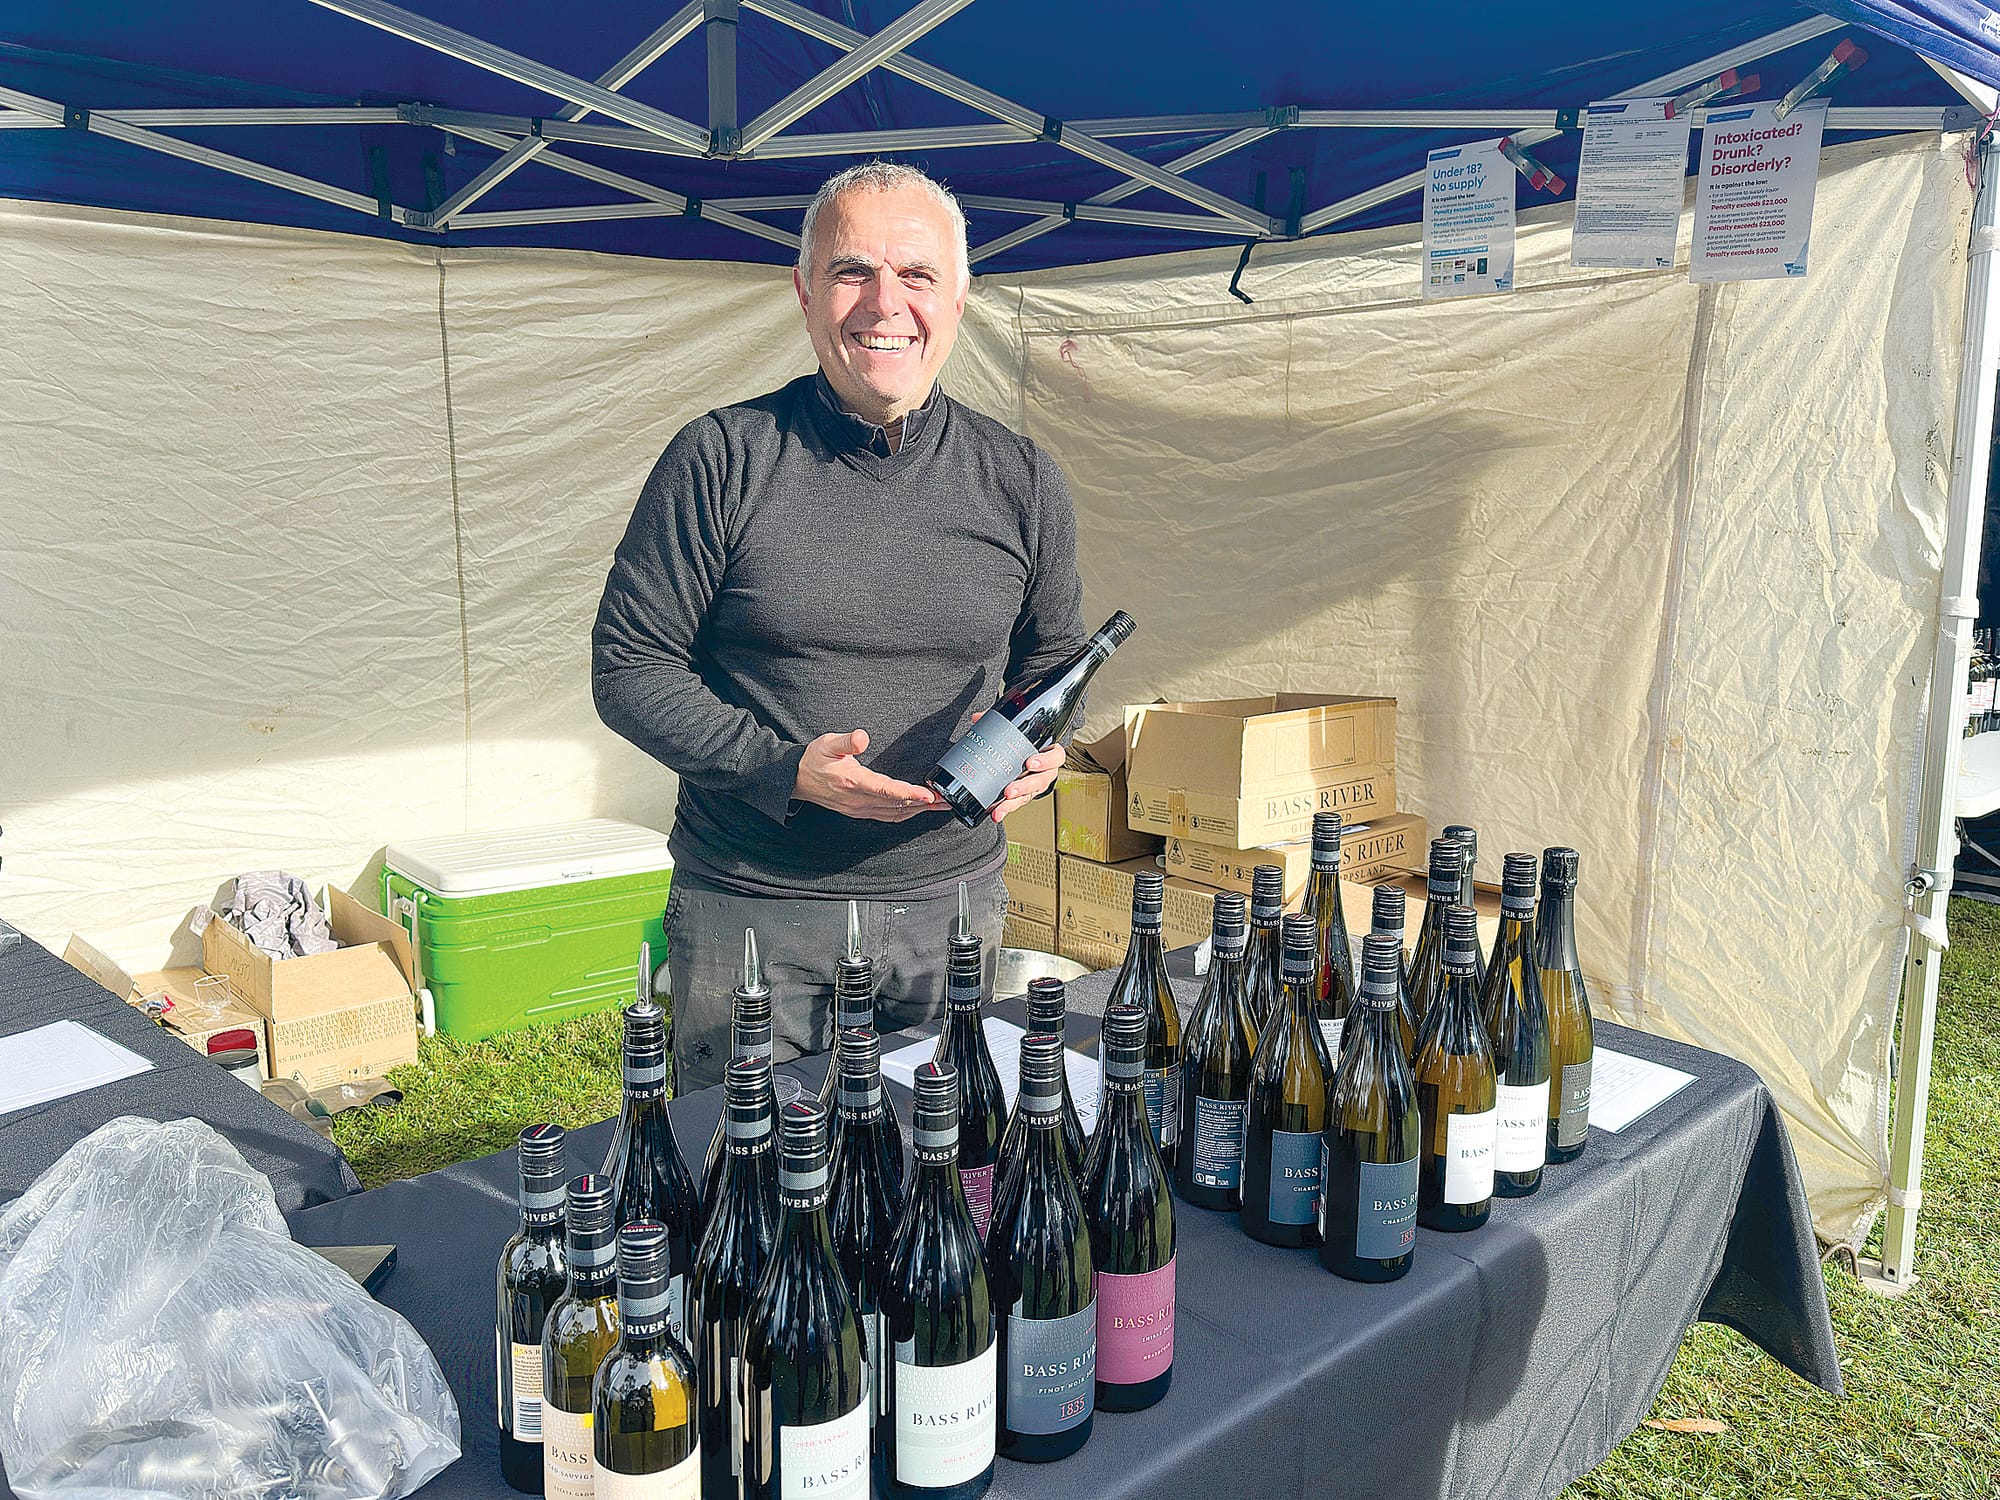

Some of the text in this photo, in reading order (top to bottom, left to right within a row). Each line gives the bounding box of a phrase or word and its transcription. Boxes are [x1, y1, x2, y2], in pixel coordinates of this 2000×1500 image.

[1714, 123, 1803, 146] Intoxicated?
[1712, 144, 1763, 161] Drunk?
[1433, 163, 1483, 179] Under 18?
[1711, 156, 1792, 177] Disorderly?
[1432, 182, 1446, 192] No
[1721, 182, 1744, 190] against
[1440, 195, 1457, 203] against
[1711, 196, 1788, 212] Penalty exceeds $23,000
[1708, 217, 1784, 233] Penalty exceeds $23,000
[1731, 248, 1754, 256] exceeds
[985, 745, 1014, 775] RIVER
[1267, 783, 1375, 820] BASS RIVER
[1358, 833, 1405, 861] RIVER
[1315, 864, 1334, 872] BASS
[1342, 864, 1386, 882] PPSLAND
[1430, 893, 1452, 902] RIVER
[1137, 927, 1156, 935] RIVER
[1219, 951, 1238, 959] BASS
[1106, 1080, 1145, 1092] VER BASS
[1199, 1101, 1218, 1110] BASS
[1030, 1114, 1059, 1126] RIVER
[922, 1152, 950, 1161] BASS
[964, 1170, 988, 1179] RIVER
[1284, 1167, 1318, 1178] BASS
[1293, 1184, 1320, 1192] CHARDO
[1374, 1198, 1407, 1211] BASS
[522, 1208, 556, 1222] RIVER
[1114, 1314, 1154, 1329] BASS
[626, 1323, 666, 1335] RIVER
[1023, 1362, 1068, 1378] BASS
[1038, 1378, 1086, 1394] PINOT NOIR
[1060, 1396, 1085, 1418] 1835
[912, 1412, 959, 1427] BASS
[552, 1446, 588, 1465] BASS
[560, 1471, 594, 1480] SAUVIGN
[803, 1464, 849, 1489] BASS
